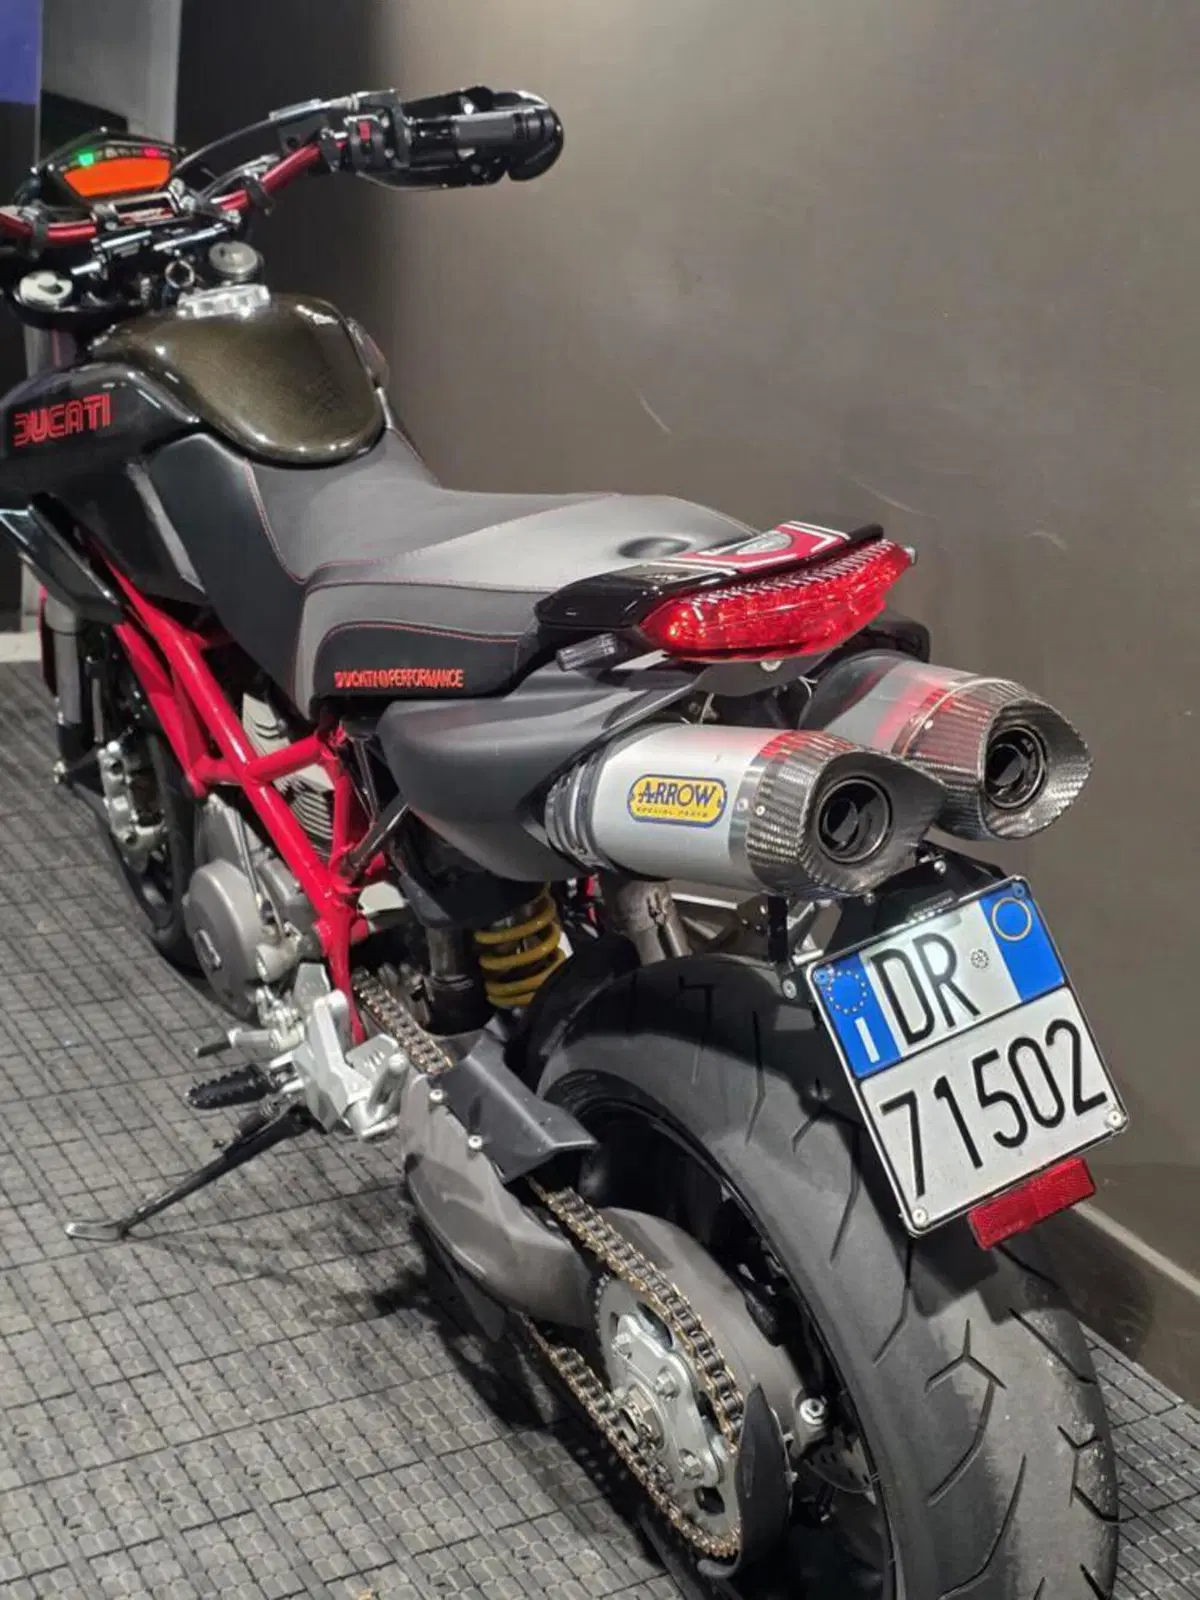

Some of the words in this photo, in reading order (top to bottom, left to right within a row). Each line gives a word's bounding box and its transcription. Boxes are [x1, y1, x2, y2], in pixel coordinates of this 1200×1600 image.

[13, 392, 111, 448] DUCATI
[388, 667, 464, 689] PERFORMANCE
[638, 780, 717, 808] ARROW
[871, 932, 980, 1045] DR
[880, 1018, 1107, 1201] 71502
